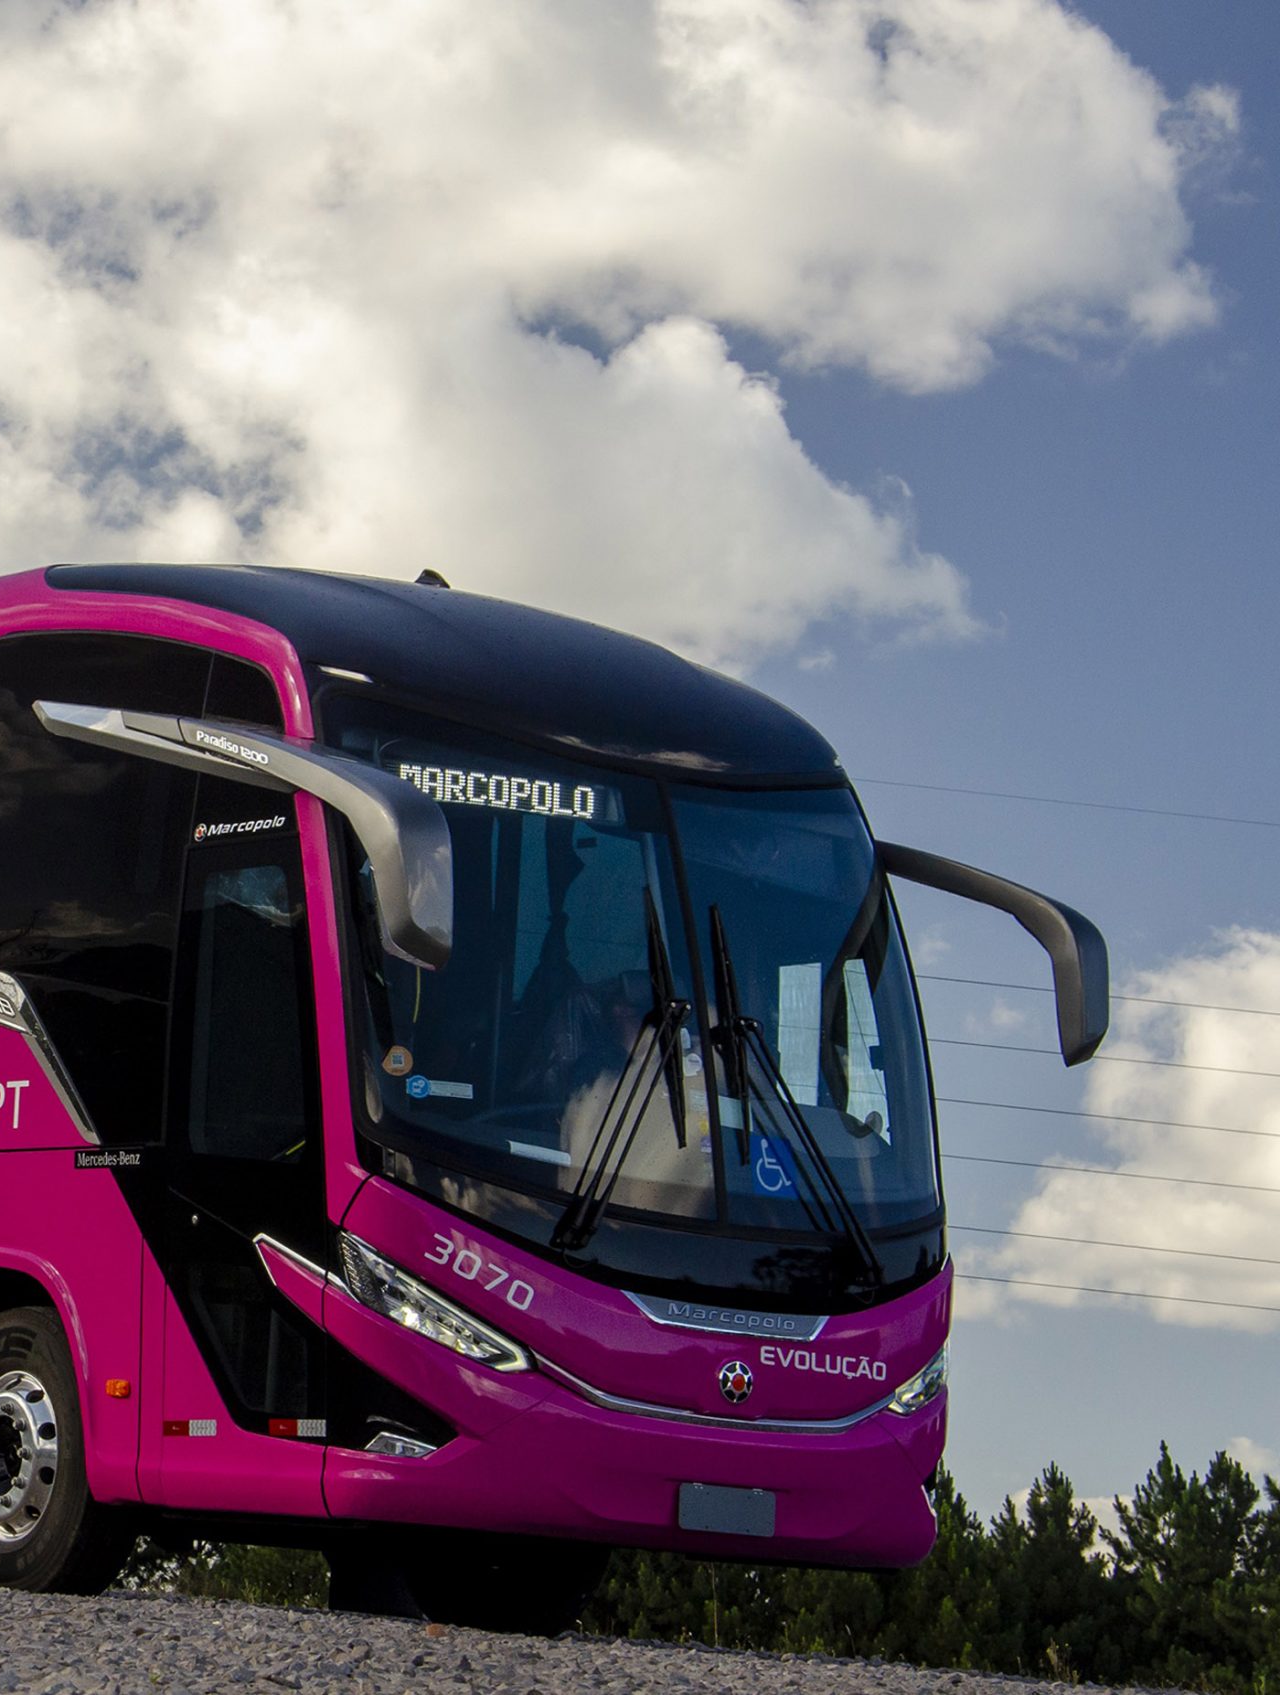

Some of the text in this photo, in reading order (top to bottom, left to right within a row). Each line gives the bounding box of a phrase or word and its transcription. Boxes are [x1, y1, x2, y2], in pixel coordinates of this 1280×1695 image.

[196, 730, 269, 765] Paradiso 1200
[400, 763, 595, 819] MARCOPOLO
[207, 815, 286, 836] Marcopolo
[76, 1151, 141, 1167] Mercedes-Benz
[423, 1232, 535, 1311] 3070
[667, 1302, 796, 1331] Marcopolo
[759, 1345, 888, 1382] EVOLUÇÃO
